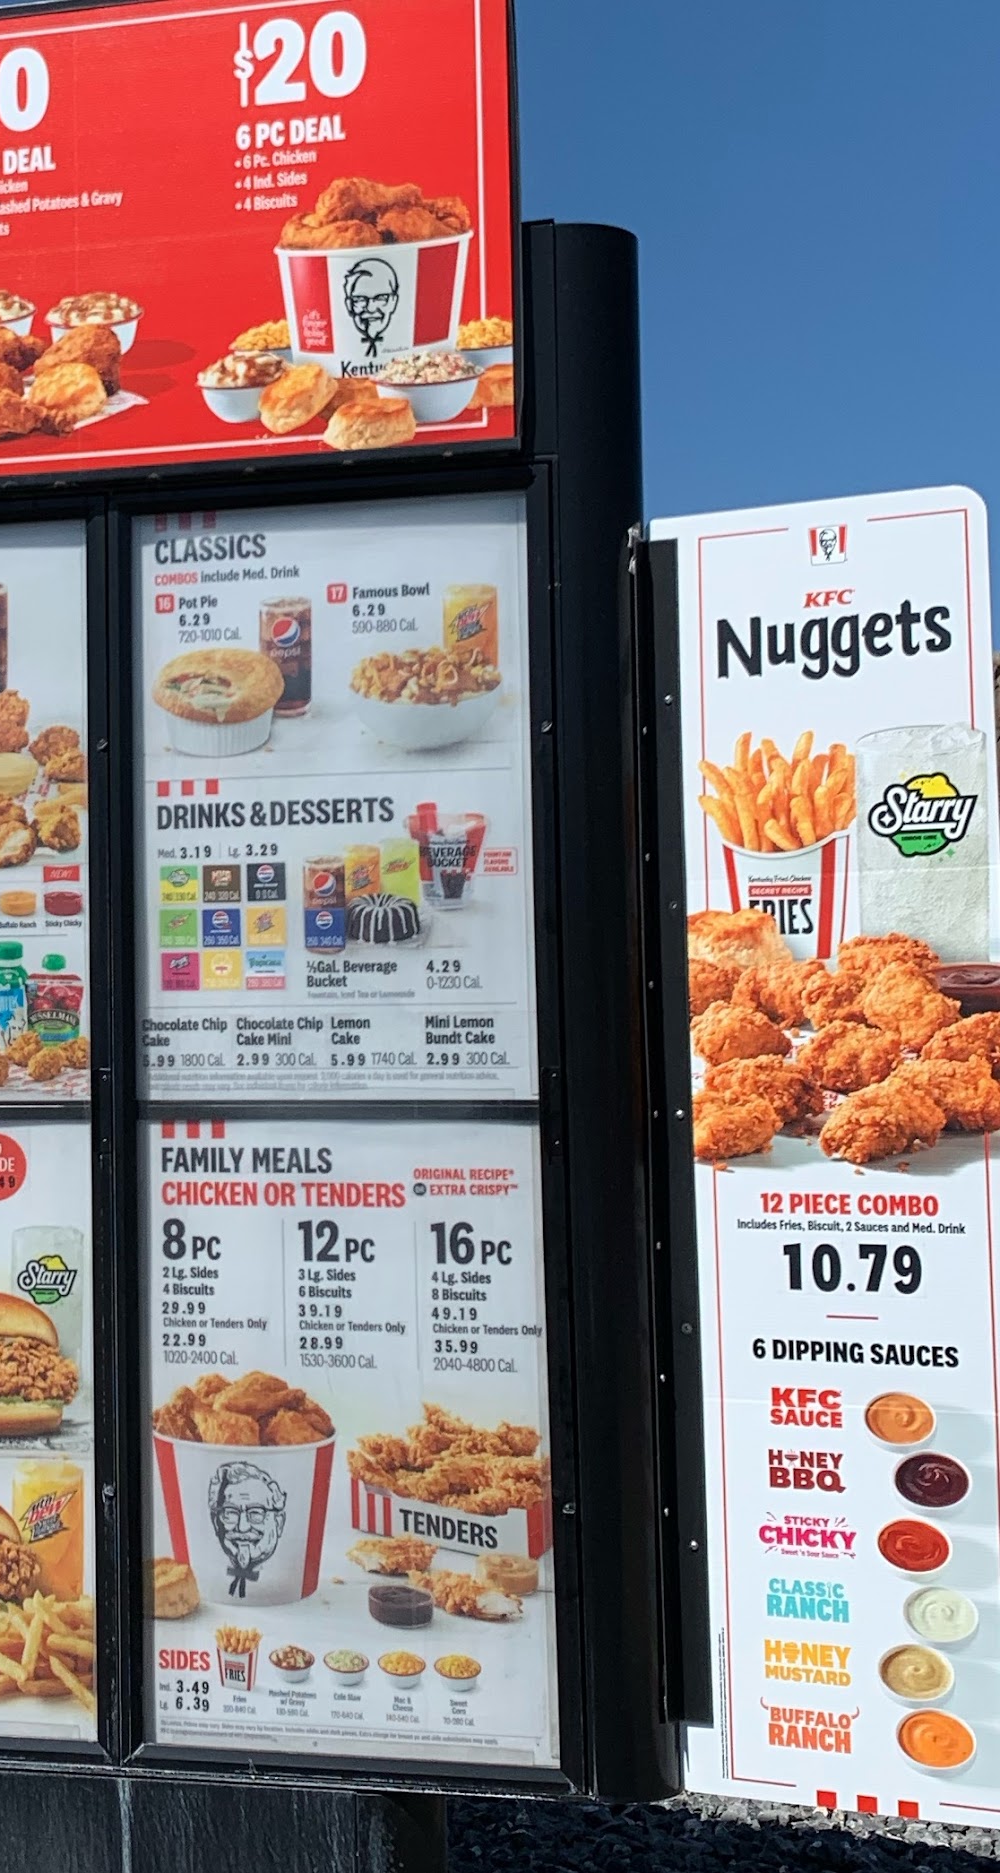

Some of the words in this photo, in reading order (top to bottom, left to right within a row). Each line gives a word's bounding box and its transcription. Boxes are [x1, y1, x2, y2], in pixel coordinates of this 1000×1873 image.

[234, 10, 367, 107] $20
[236, 125, 250, 150] 6
[255, 122, 284, 147] PC
[289, 115, 346, 144] DEAL
[3, 145, 56, 172] DEAL
[155, 534, 266, 565] CLASSICS
[352, 585, 398, 599] Famous
[401, 582, 430, 596] Bowl
[803, 589, 855, 608] KFC
[352, 604, 385, 617] 6.29
[717, 599, 952, 679] Nuggets
[157, 804, 245, 830] DRINKS
[250, 804, 267, 826] &
[270, 797, 394, 825] DESSERTS
[868, 783, 978, 839] Starry
[426, 960, 461, 973] 4.29
[426, 1032, 461, 1045] Bundt
[463, 1032, 495, 1045] Cake
[161, 1147, 244, 1173] FAMILY
[253, 1147, 332, 1174] MEALS
[161, 1182, 257, 1206] CHICKEN
[264, 1183, 296, 1206] OR
[302, 1183, 406, 1208] TENDERS
[760, 1193, 783, 1213] 12
[790, 1194, 851, 1215] PIECE
[858, 1195, 939, 1216] COMBO
[737, 1219, 777, 1230] Includes
[779, 1220, 805, 1232] Fries,
[808, 1221, 844, 1232] Biscuit,
[846, 1222, 852, 1231] 2
[854, 1222, 888, 1233] Sauces
[891, 1223, 909, 1233] and
[912, 1224, 936, 1234] Med.
[938, 1224, 966, 1234] Drink
[783, 1243, 922, 1295] 10.79
[162, 1301, 206, 1315] 29.99
[298, 1304, 342, 1318] 39.19
[431, 1307, 478, 1321] 49.19
[753, 1338, 766, 1359] 6
[772, 1340, 864, 1363] DIPPING
[870, 1344, 959, 1367] SAUCES
[771, 1387, 842, 1410] KFC
[770, 1410, 843, 1428] SAUCE
[768, 1467, 846, 1493] BBQ
[400, 1508, 498, 1548] TENDERS
[784, 1515, 830, 1527] STICKY
[759, 1526, 856, 1550] CHICKY
[768, 1578, 844, 1598] CLASSIC
[767, 1594, 849, 1623] RANCH
[159, 1650, 210, 1671] SIDES
[176, 1681, 210, 1695] 3.49
[765, 1666, 851, 1687] MUSTARD
[175, 1698, 210, 1712] 6.39
[770, 1706, 851, 1729] BUFFALO
[768, 1723, 852, 1754] RANCH
